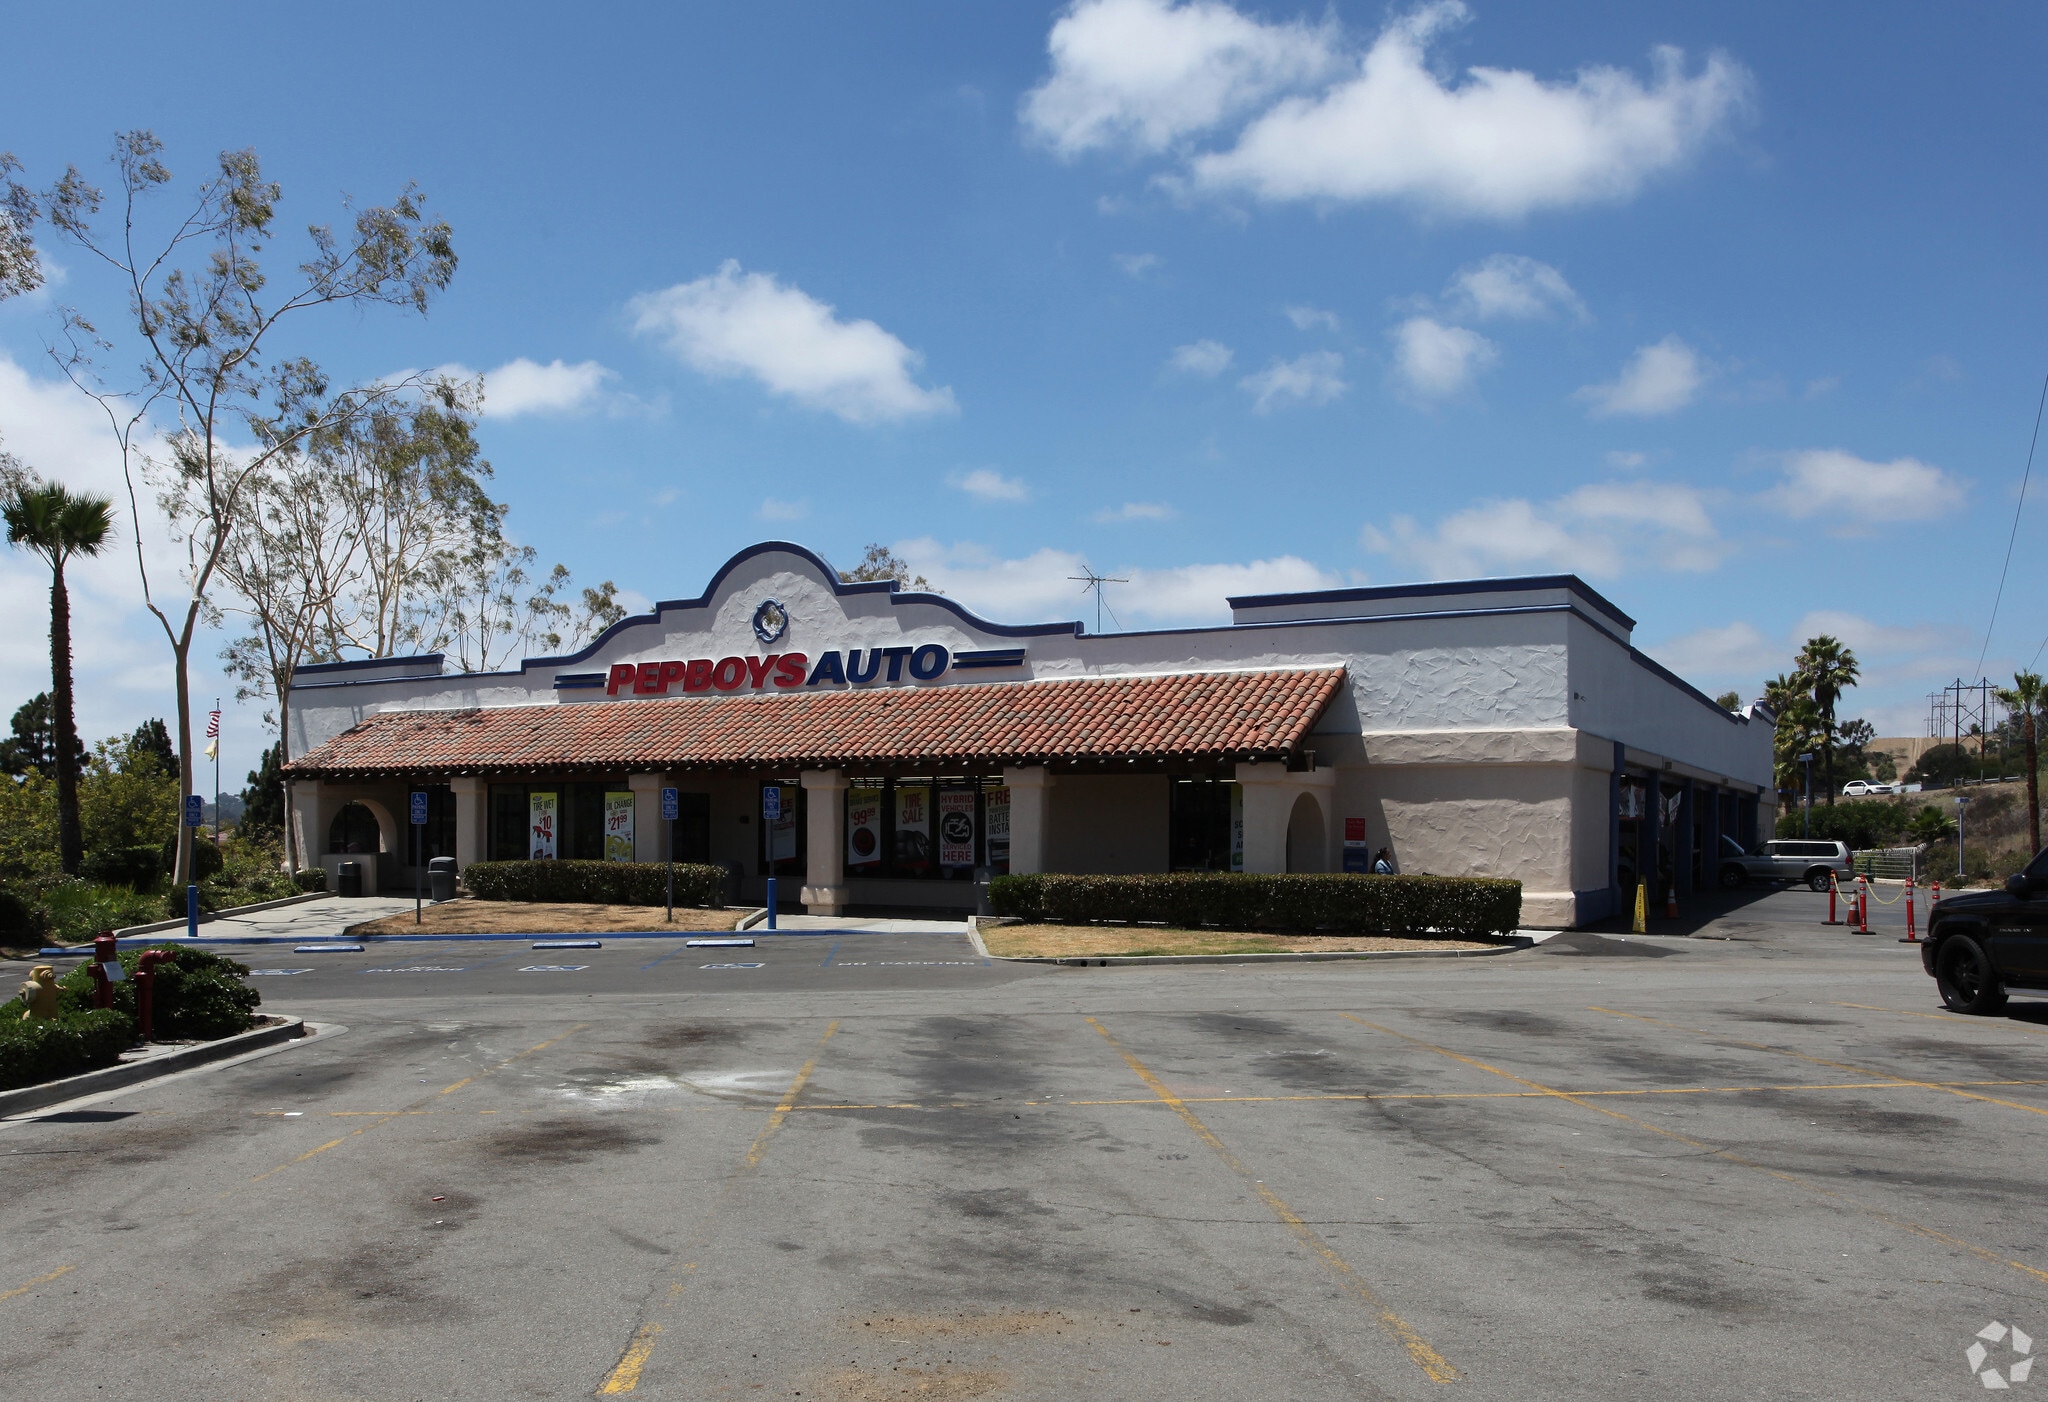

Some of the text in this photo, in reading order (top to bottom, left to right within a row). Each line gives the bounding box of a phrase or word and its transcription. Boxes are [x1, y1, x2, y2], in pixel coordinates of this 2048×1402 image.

[806, 643, 949, 686] AUTO
[614, 798, 633, 809] CHANGE
[904, 792, 922, 808] TIRE
[941, 794, 974, 804] HYBRID
[533, 799, 554, 811] TIRE WET
[941, 804, 974, 812] VEHICLES
[902, 808, 924, 824] SALE
[942, 851, 972, 862] HERE
